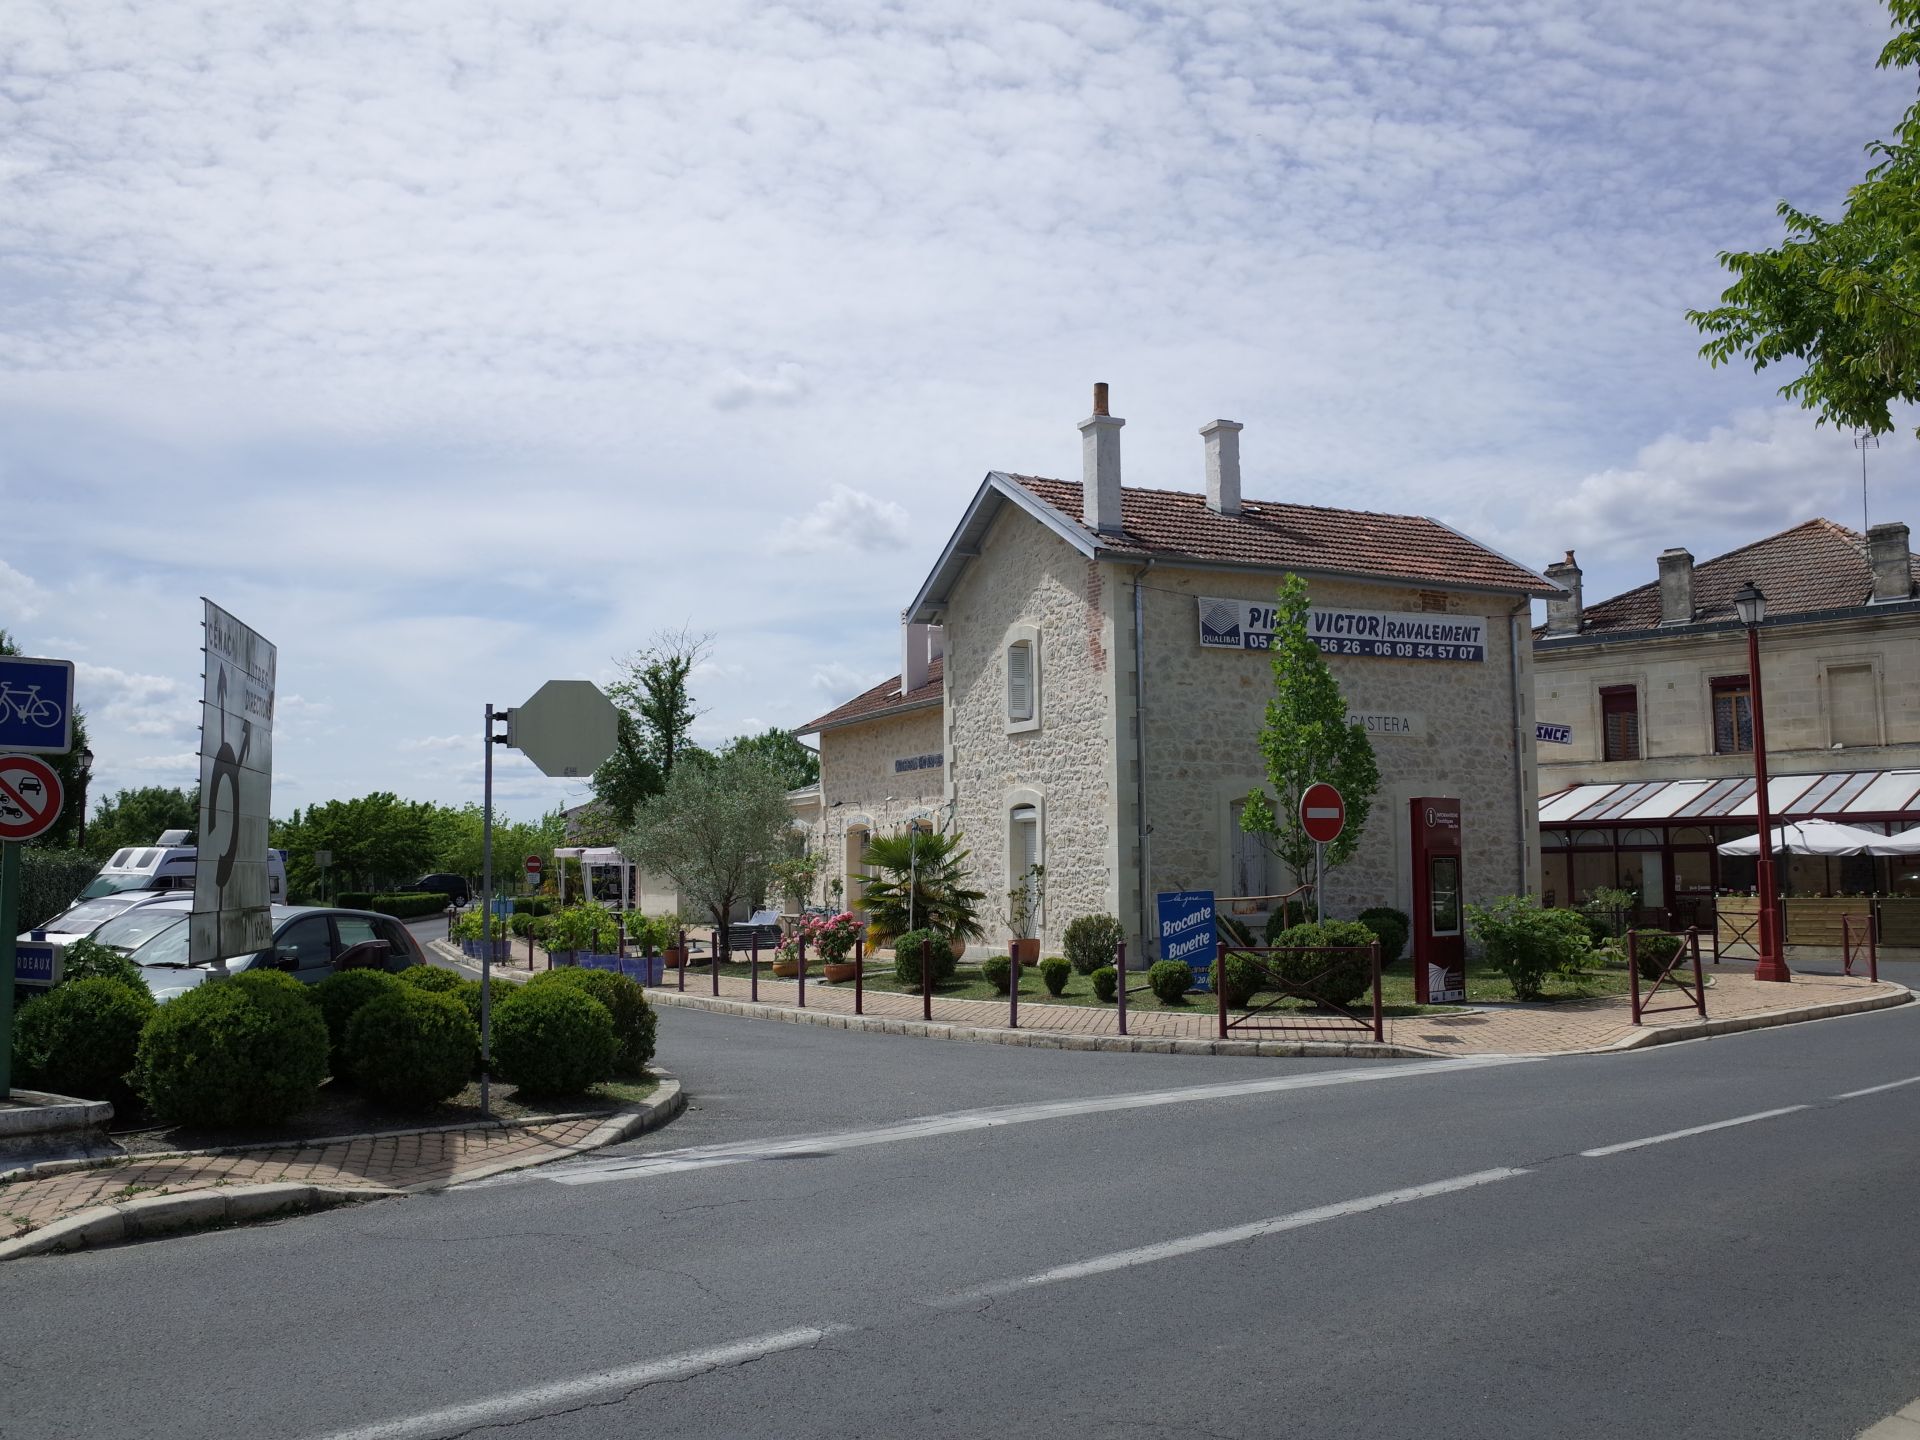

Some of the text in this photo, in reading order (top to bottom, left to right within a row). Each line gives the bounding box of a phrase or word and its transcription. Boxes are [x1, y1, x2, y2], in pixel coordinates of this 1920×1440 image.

[1314, 612, 1379, 638] VICTOR
[1387, 621, 1480, 643] RAVALEMENT
[1203, 634, 1239, 644] QUALIBAT
[1249, 635, 1268, 648] 05
[1320, 639, 1338, 652] 56
[1343, 640, 1360, 653] 26
[1374, 642, 1391, 655] 06
[1396, 643, 1413, 656] 08
[1417, 645, 1434, 658] 54
[1438, 646, 1454, 659] 57
[1459, 647, 1475, 660] 07
[1536, 726, 1569, 741] SNCF
[1162, 907, 1211, 937] Brocante
[1168, 932, 1210, 959] Buvette
[17, 957, 51, 971] RDEAUX
